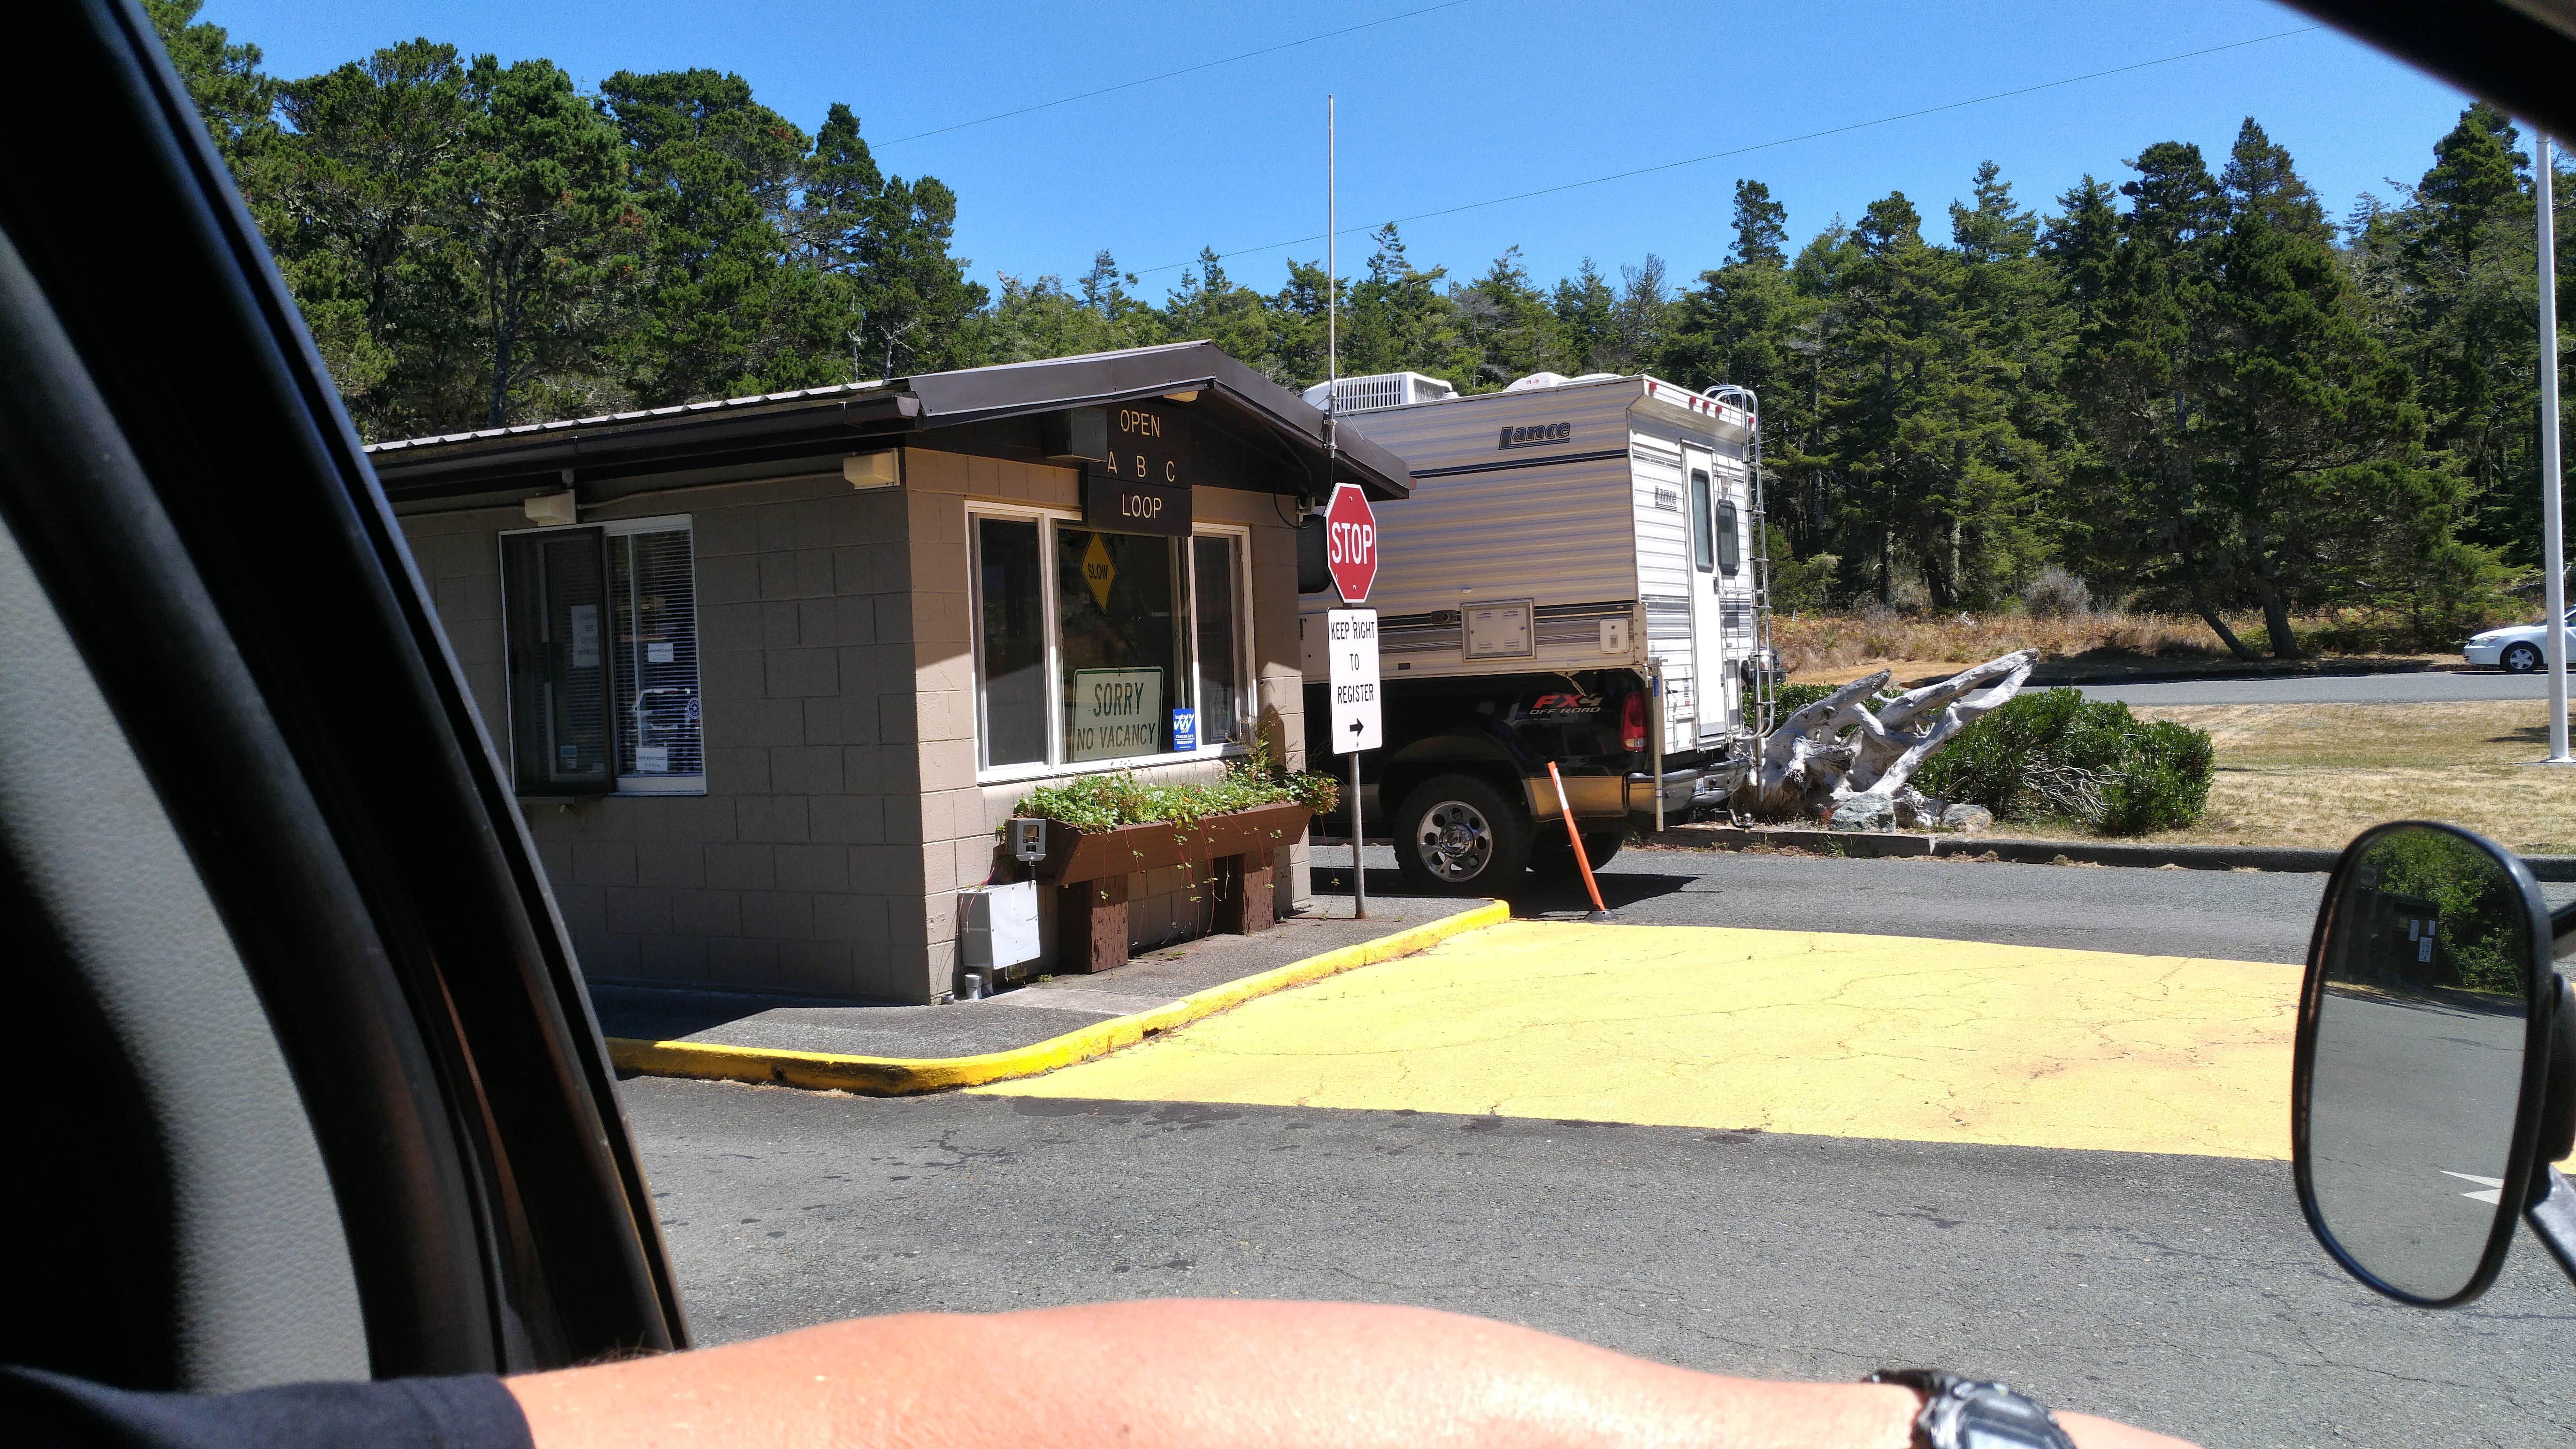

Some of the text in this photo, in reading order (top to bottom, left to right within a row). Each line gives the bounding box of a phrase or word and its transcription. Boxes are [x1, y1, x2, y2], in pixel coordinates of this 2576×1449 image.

[1120, 409, 1160, 438] OPEN
[1498, 422, 1571, 450] Lance
[1107, 451, 1175, 482] A B C
[1122, 494, 1162, 519] LOOP
[1332, 521, 1372, 564] STOP
[1088, 563, 1108, 580] SLOW
[1331, 621, 1375, 640] KEEP RIGHT
[1349, 653, 1359, 671] TO
[1093, 682, 1144, 717] SORRY
[1338, 684, 1374, 704] REGISTER
[1533, 694, 1603, 709] FX4
[1077, 723, 1156, 751] NO VACANCY
